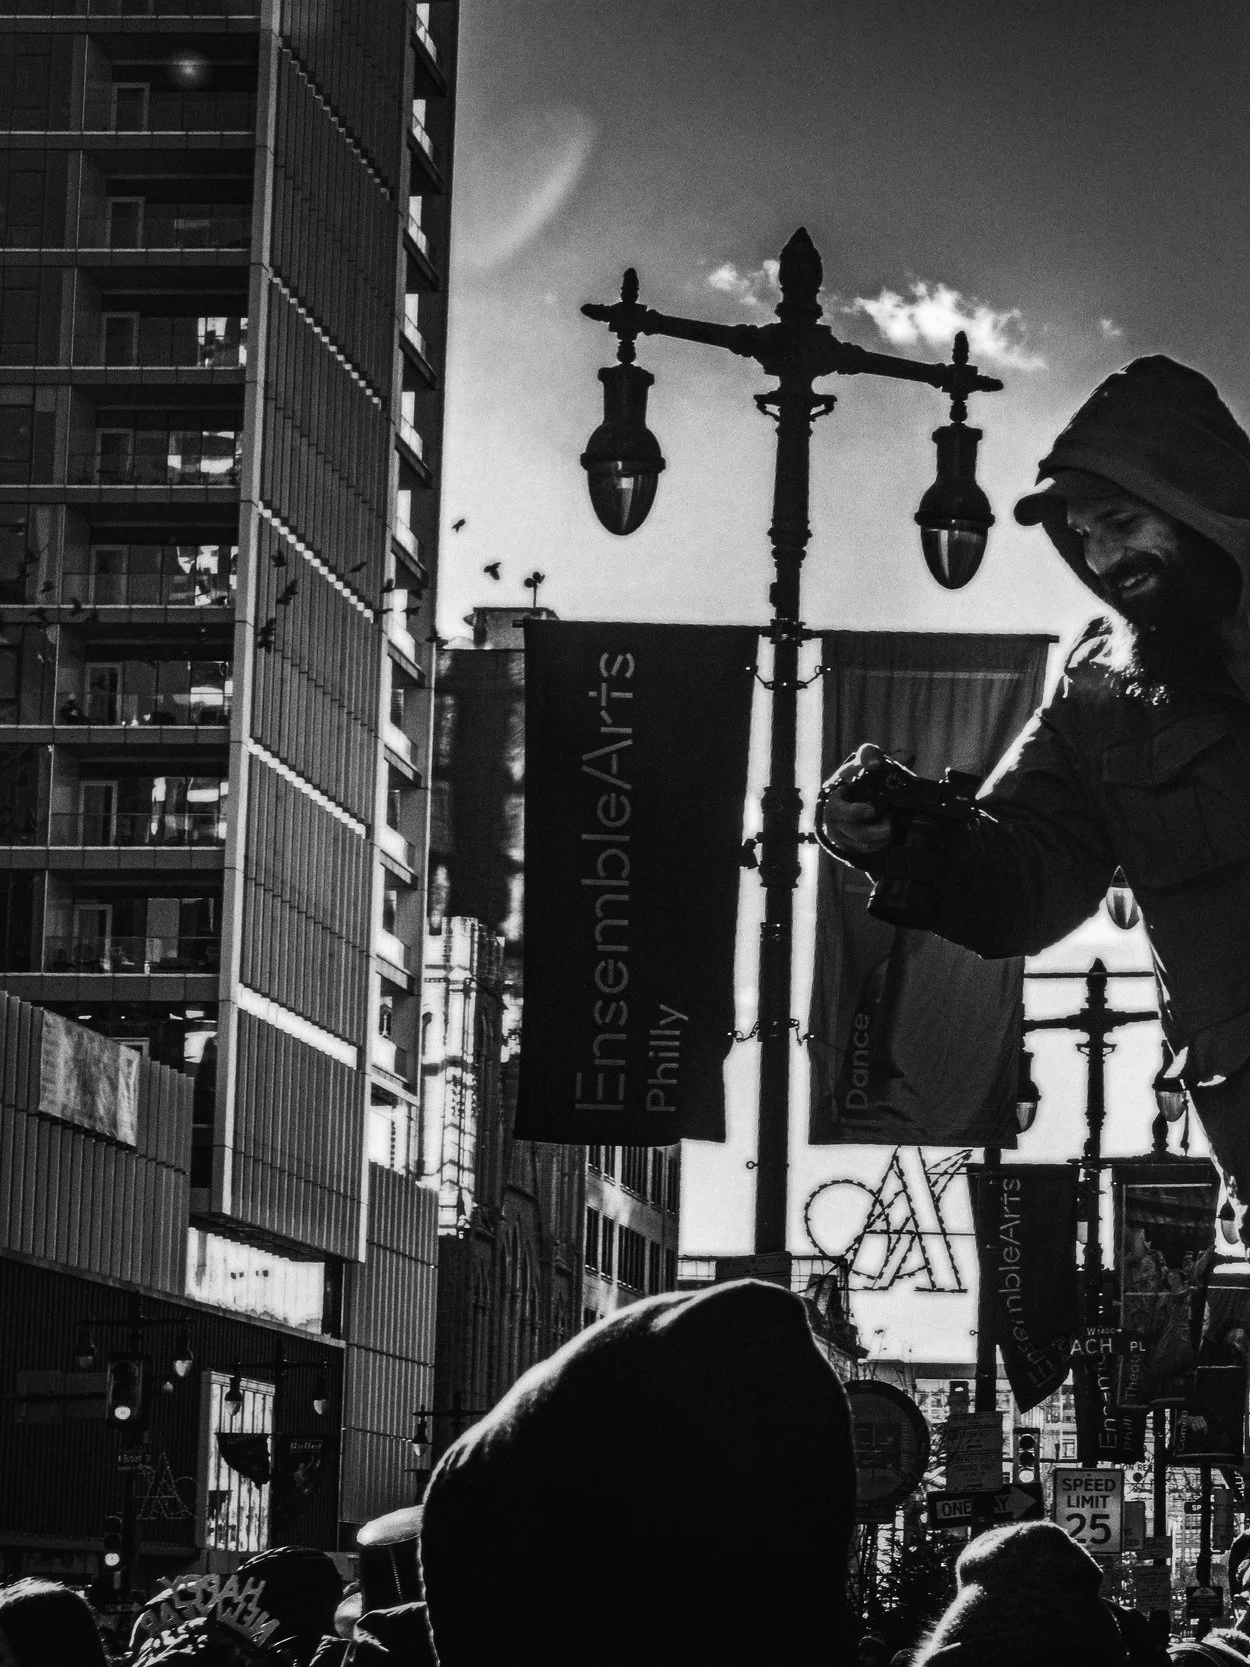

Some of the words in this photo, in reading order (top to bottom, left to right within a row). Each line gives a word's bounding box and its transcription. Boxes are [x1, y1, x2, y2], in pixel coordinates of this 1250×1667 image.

[575, 651, 636, 1112] EnsembleArts
[645, 1003, 690, 1113] Philly
[844, 1011, 871, 1111] Dance
[1070, 1337, 1112, 1355] ACH
[1129, 1340, 1146, 1352] PL
[1061, 1476, 1117, 1493] SPEED
[941, 1500, 972, 1517] ONE
[1067, 1494, 1110, 1509] LIMIT
[1065, 1512, 1112, 1545] 25
